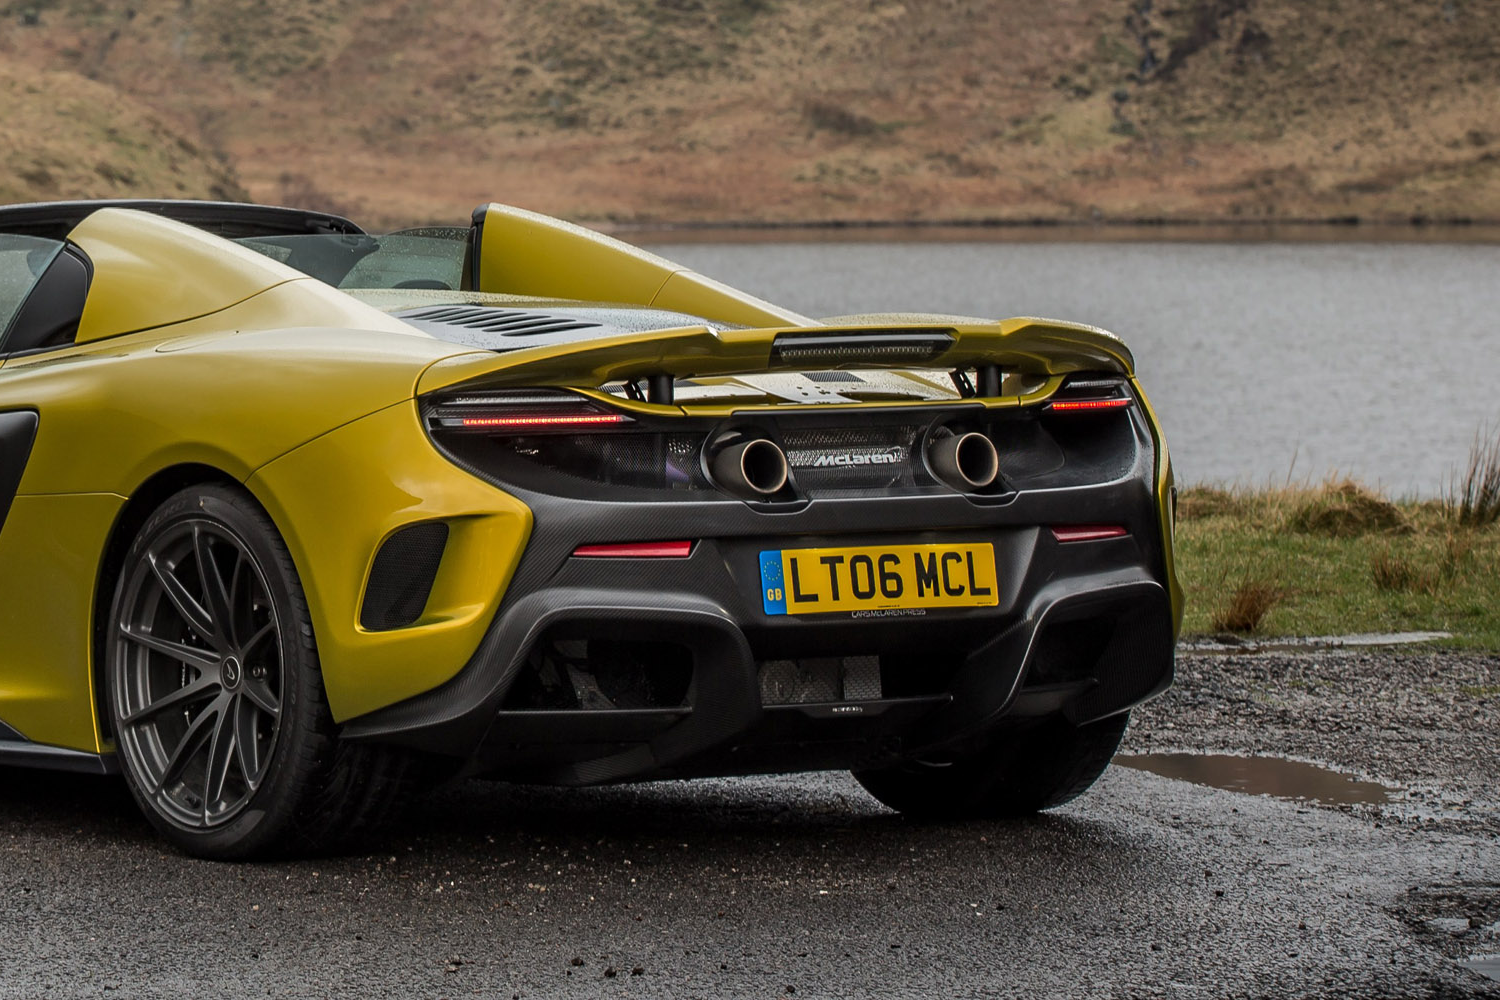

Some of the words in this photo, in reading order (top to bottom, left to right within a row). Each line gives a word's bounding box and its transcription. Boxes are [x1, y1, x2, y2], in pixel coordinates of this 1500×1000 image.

[814, 453, 894, 467] McLaren
[791, 553, 904, 603] LT06
[914, 551, 991, 598] MCL
[767, 588, 782, 601] GB
